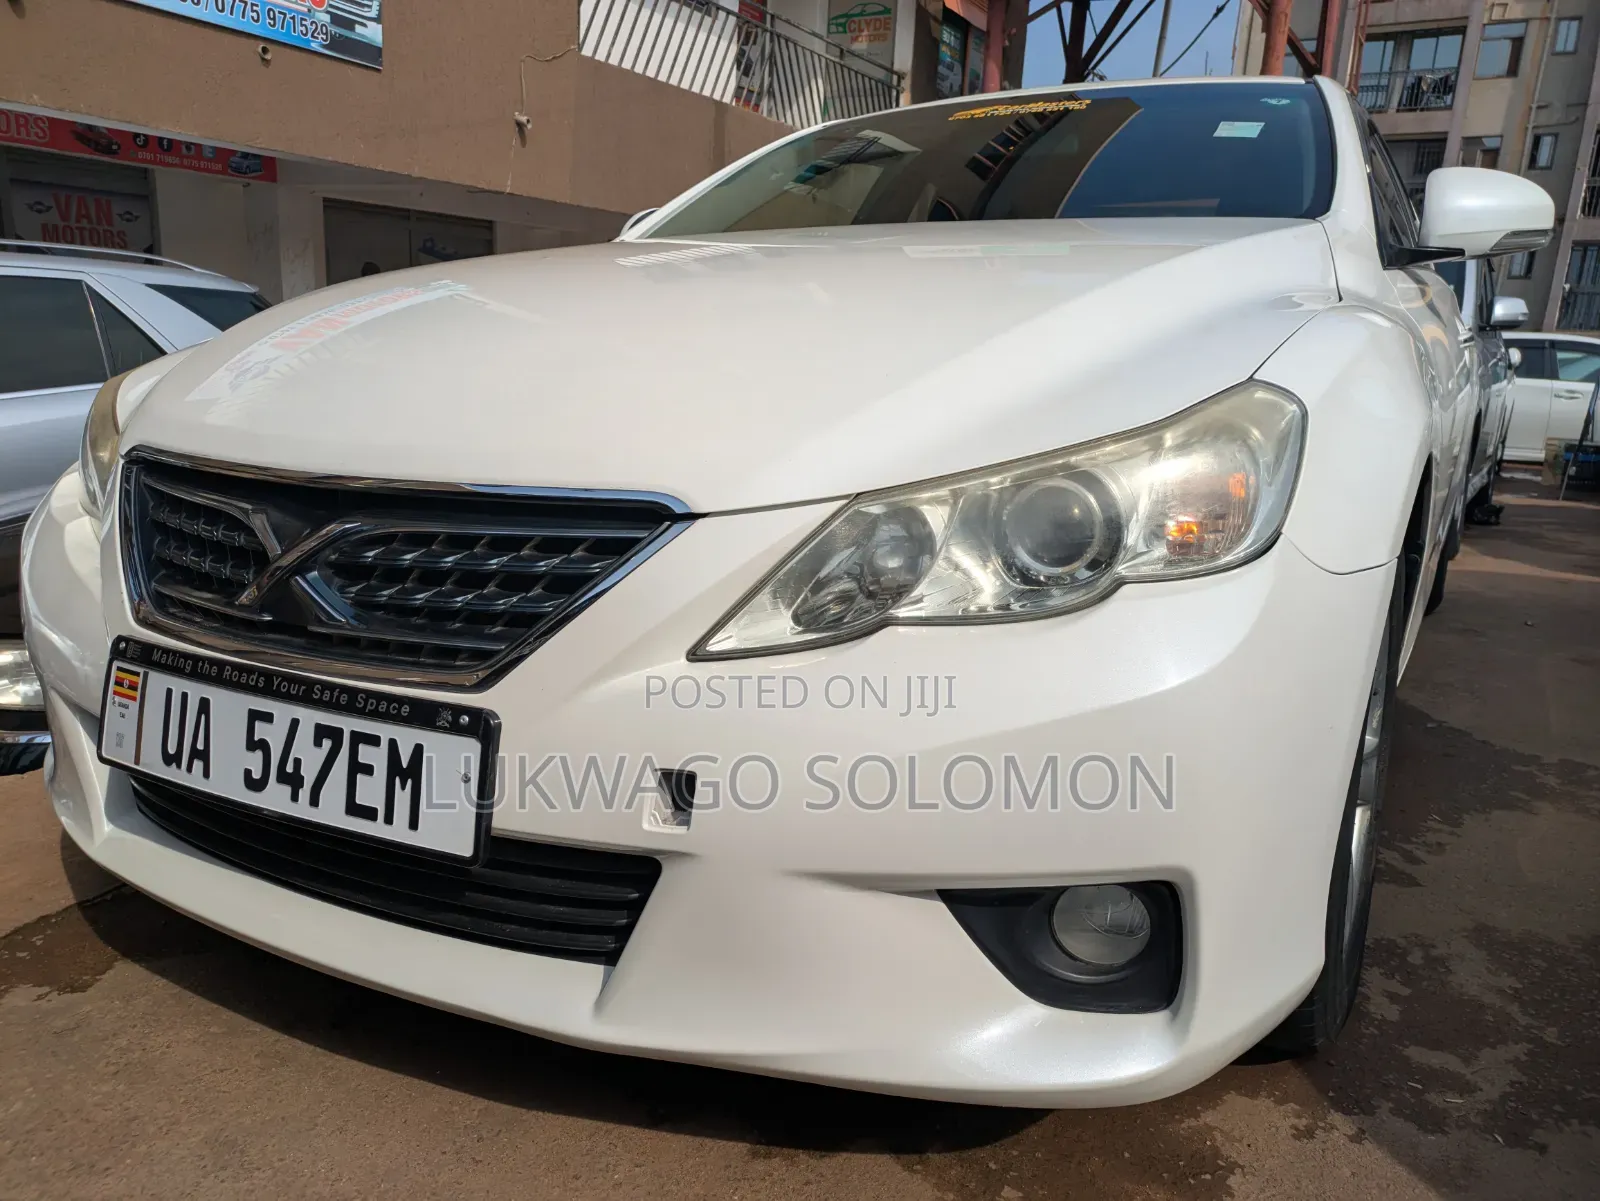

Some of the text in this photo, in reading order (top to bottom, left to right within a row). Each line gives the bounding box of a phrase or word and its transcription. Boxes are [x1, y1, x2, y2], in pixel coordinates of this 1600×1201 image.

[266, 7, 331, 44] 971529
[847, 16, 892, 33] CLYDE
[52, 192, 114, 227] VAN
[41, 222, 128, 249] MOTORS
[152, 648, 410, 716] Making the Roads Your Safe Space
[160, 686, 424, 832] UA 547EM
